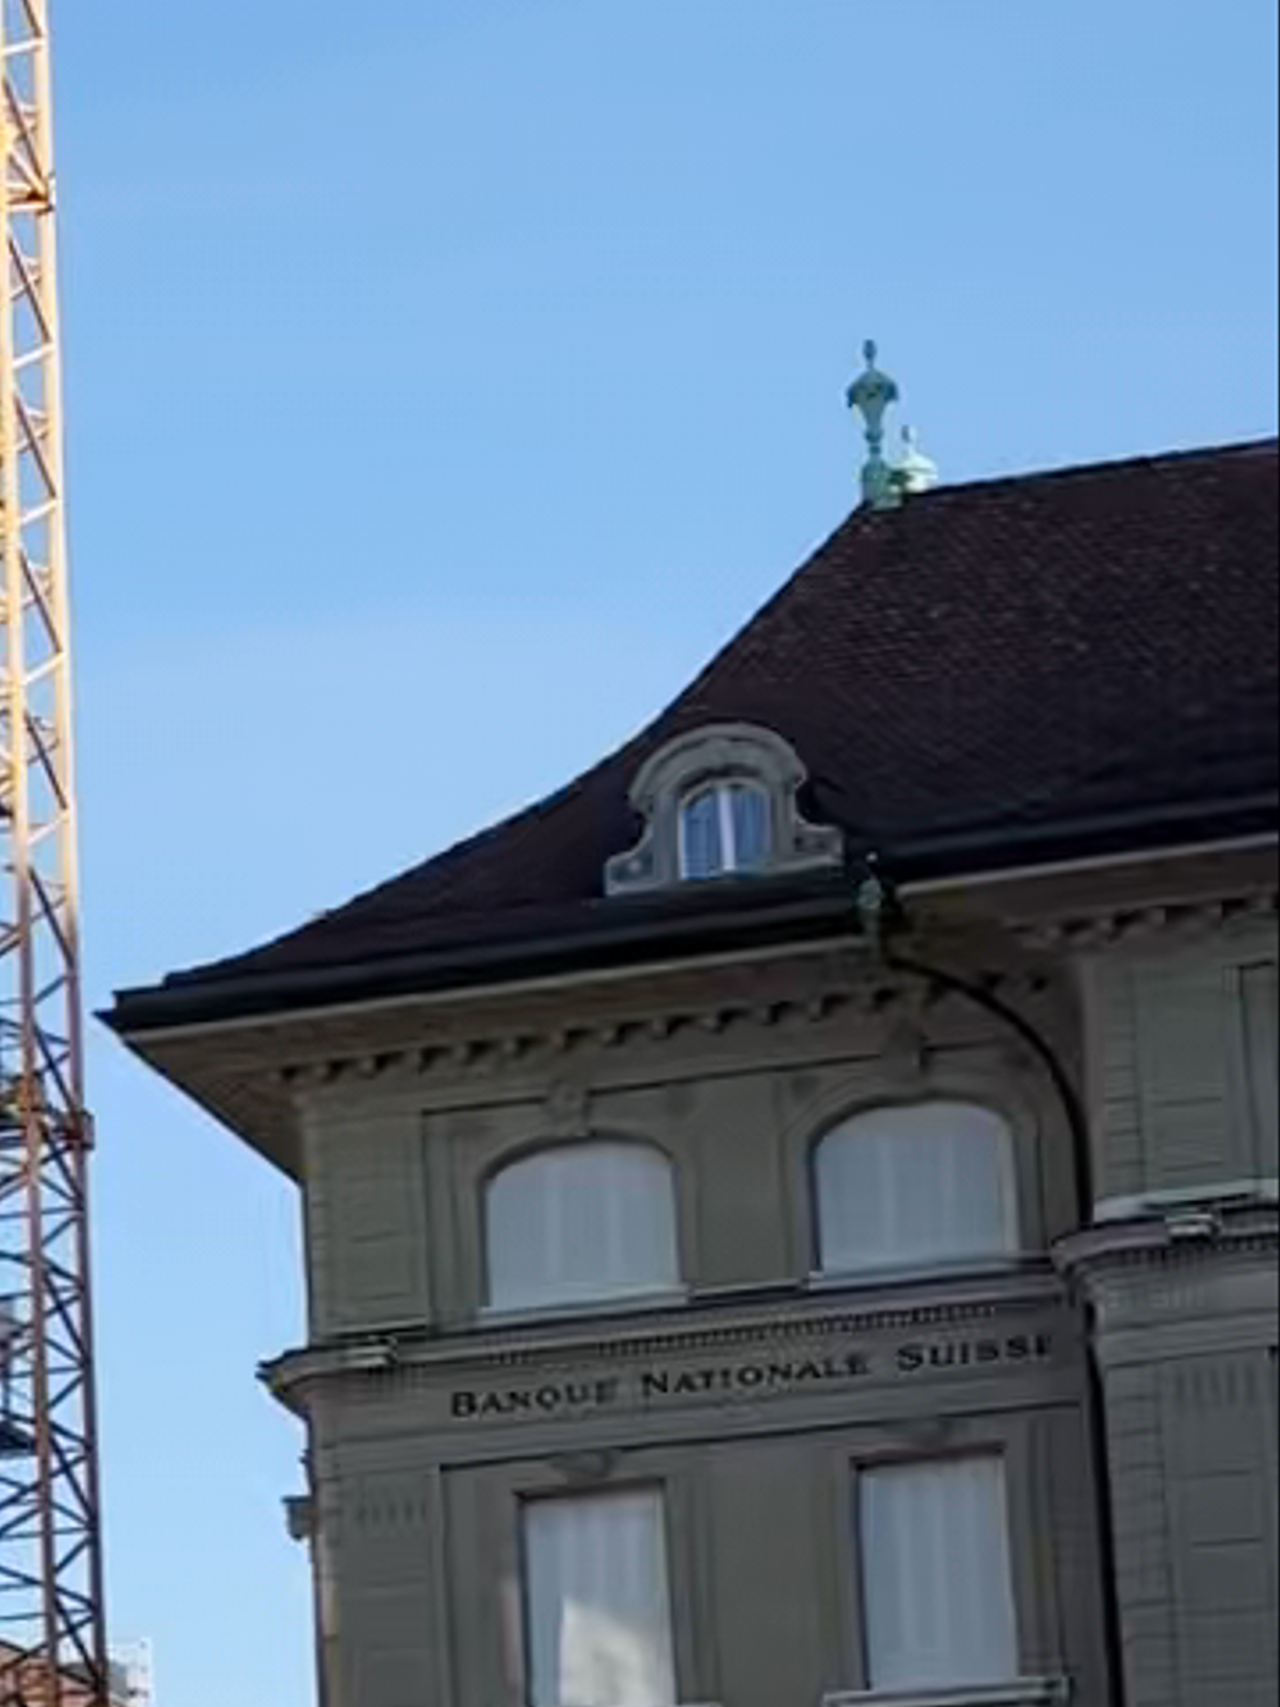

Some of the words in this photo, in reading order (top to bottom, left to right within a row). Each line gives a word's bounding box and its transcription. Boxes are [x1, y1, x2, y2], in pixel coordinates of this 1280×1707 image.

[450, 1376, 618, 1417] BANQUE
[640, 1351, 869, 1398] NATIONALE
[896, 1335, 1051, 1371] SUISSE
